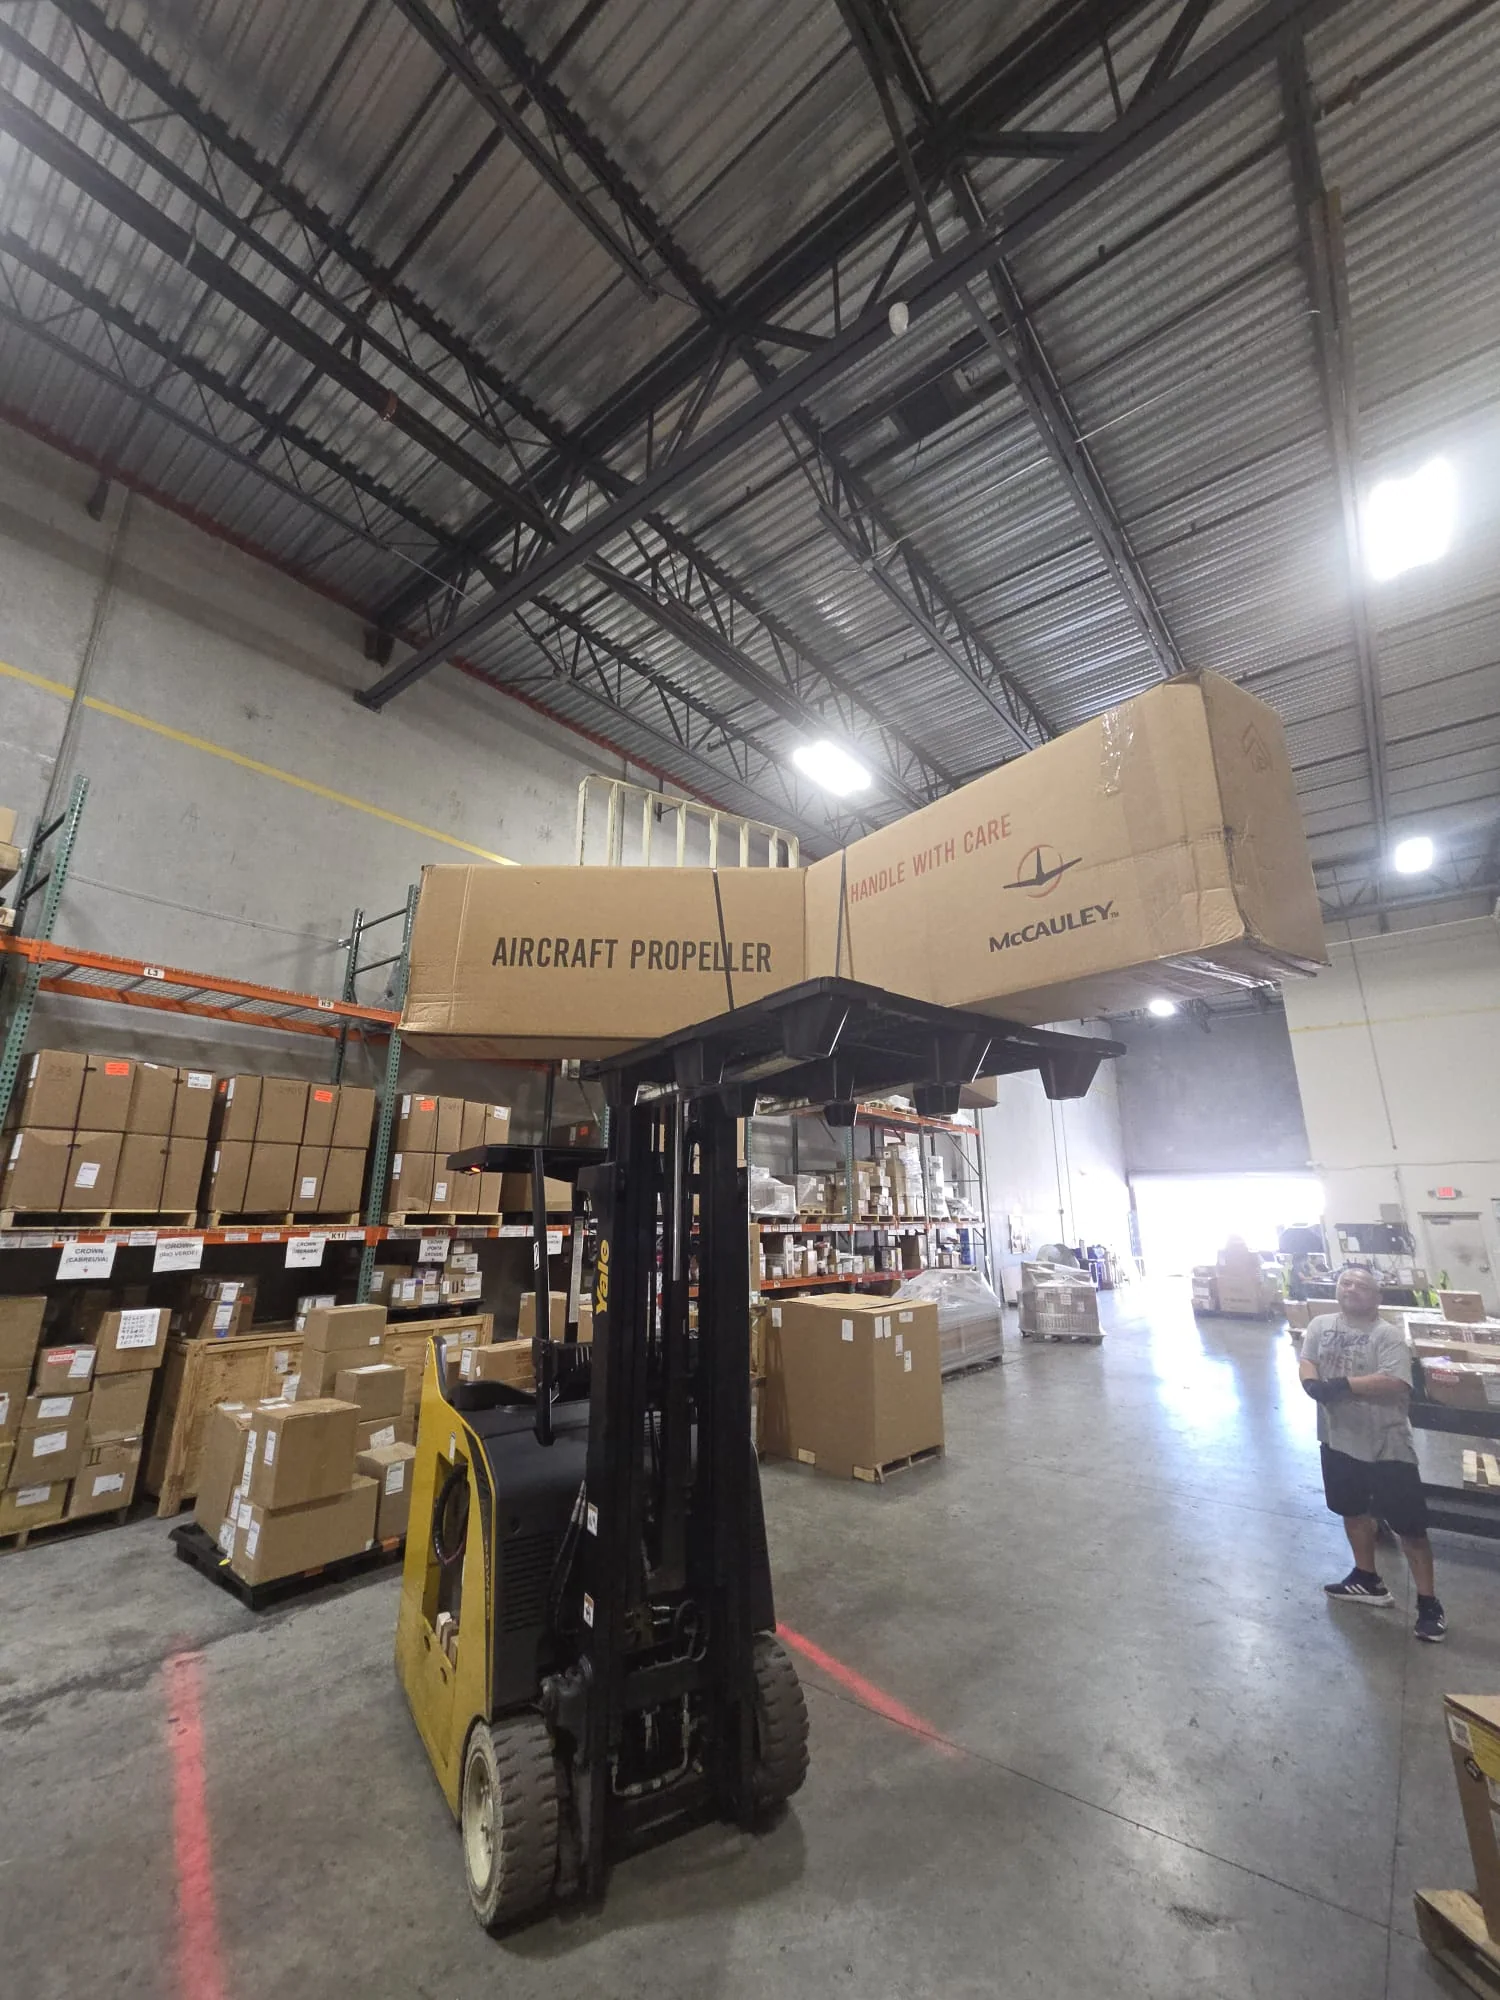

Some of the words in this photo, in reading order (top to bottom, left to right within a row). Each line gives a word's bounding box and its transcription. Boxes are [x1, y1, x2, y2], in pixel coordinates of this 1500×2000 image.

[850, 861, 905, 904] HANDLE
[912, 837, 956, 877] WITH
[964, 813, 1012, 855] CARE
[491, 936, 618, 969] AIRCRAFT
[630, 940, 772, 973] PROPELLER
[74, 1247, 105, 1255] CROWN
[595, 1239, 610, 1315] Yale
